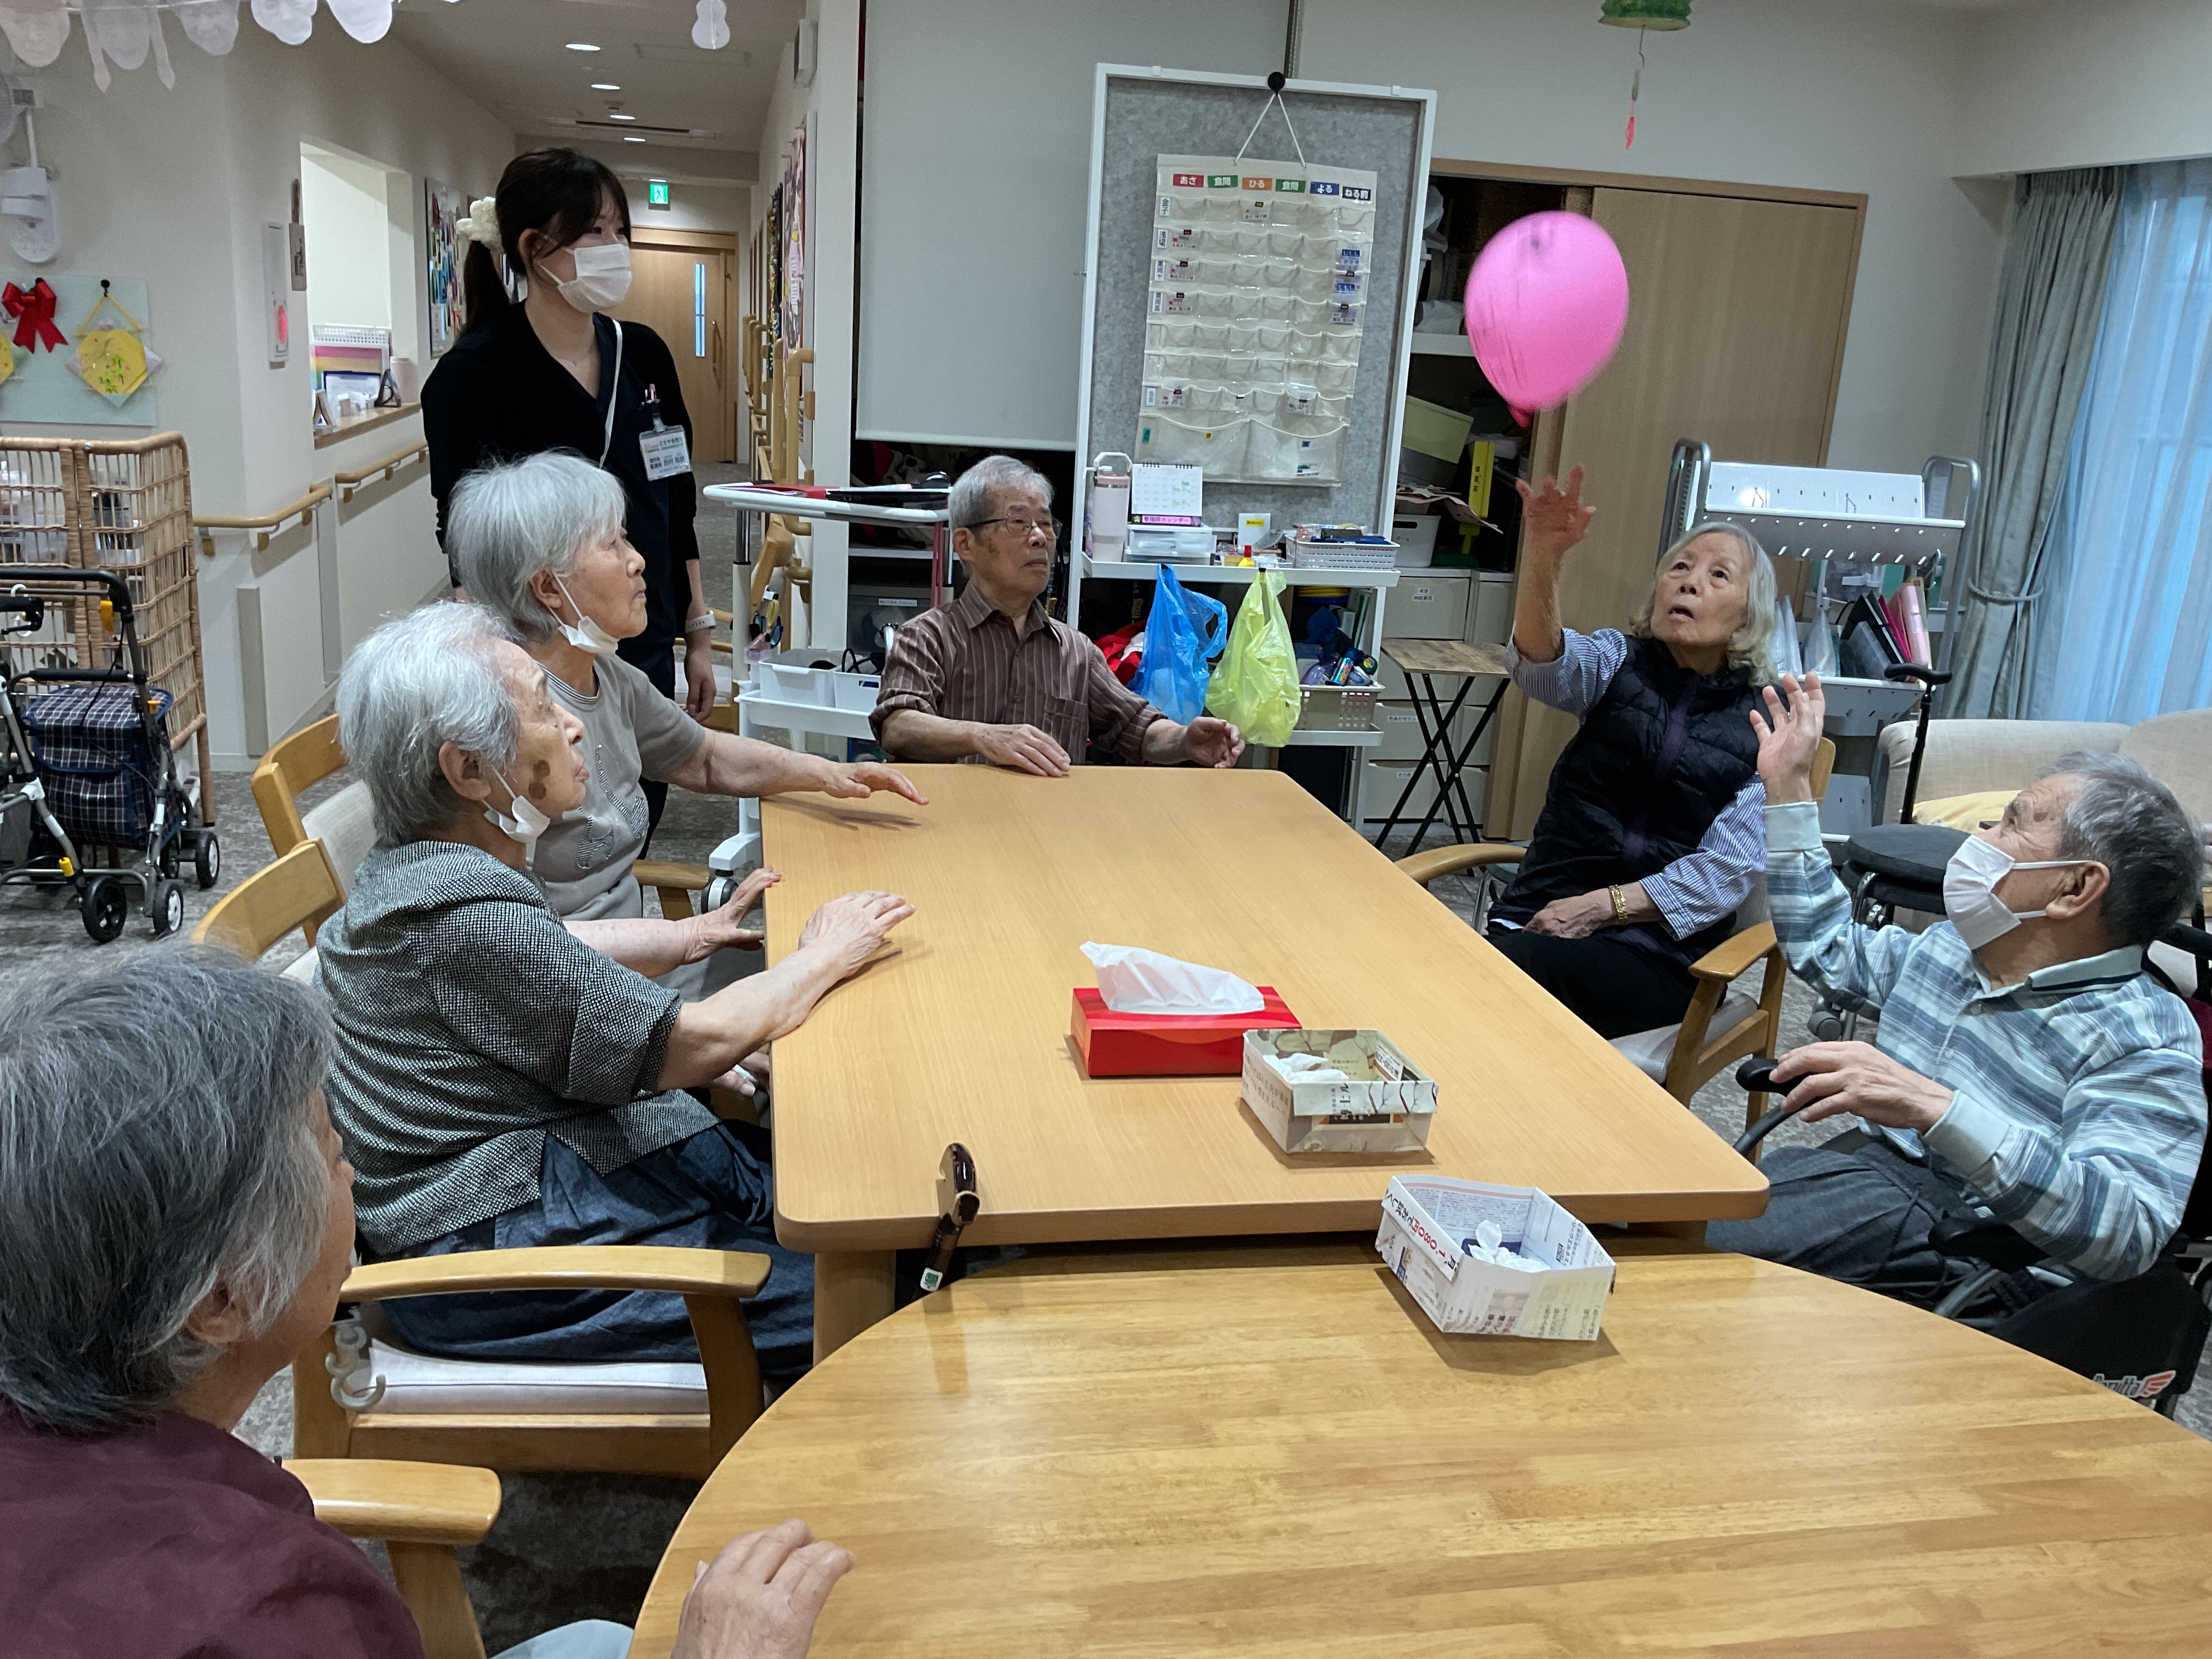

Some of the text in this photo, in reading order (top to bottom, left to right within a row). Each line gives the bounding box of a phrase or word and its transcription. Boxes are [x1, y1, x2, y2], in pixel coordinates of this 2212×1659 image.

[1180, 176, 1197, 185] あさ
[1249, 180, 1265, 188] ひる
[1317, 184, 1333, 194] よる
[1345, 189, 1369, 199] ねる前
